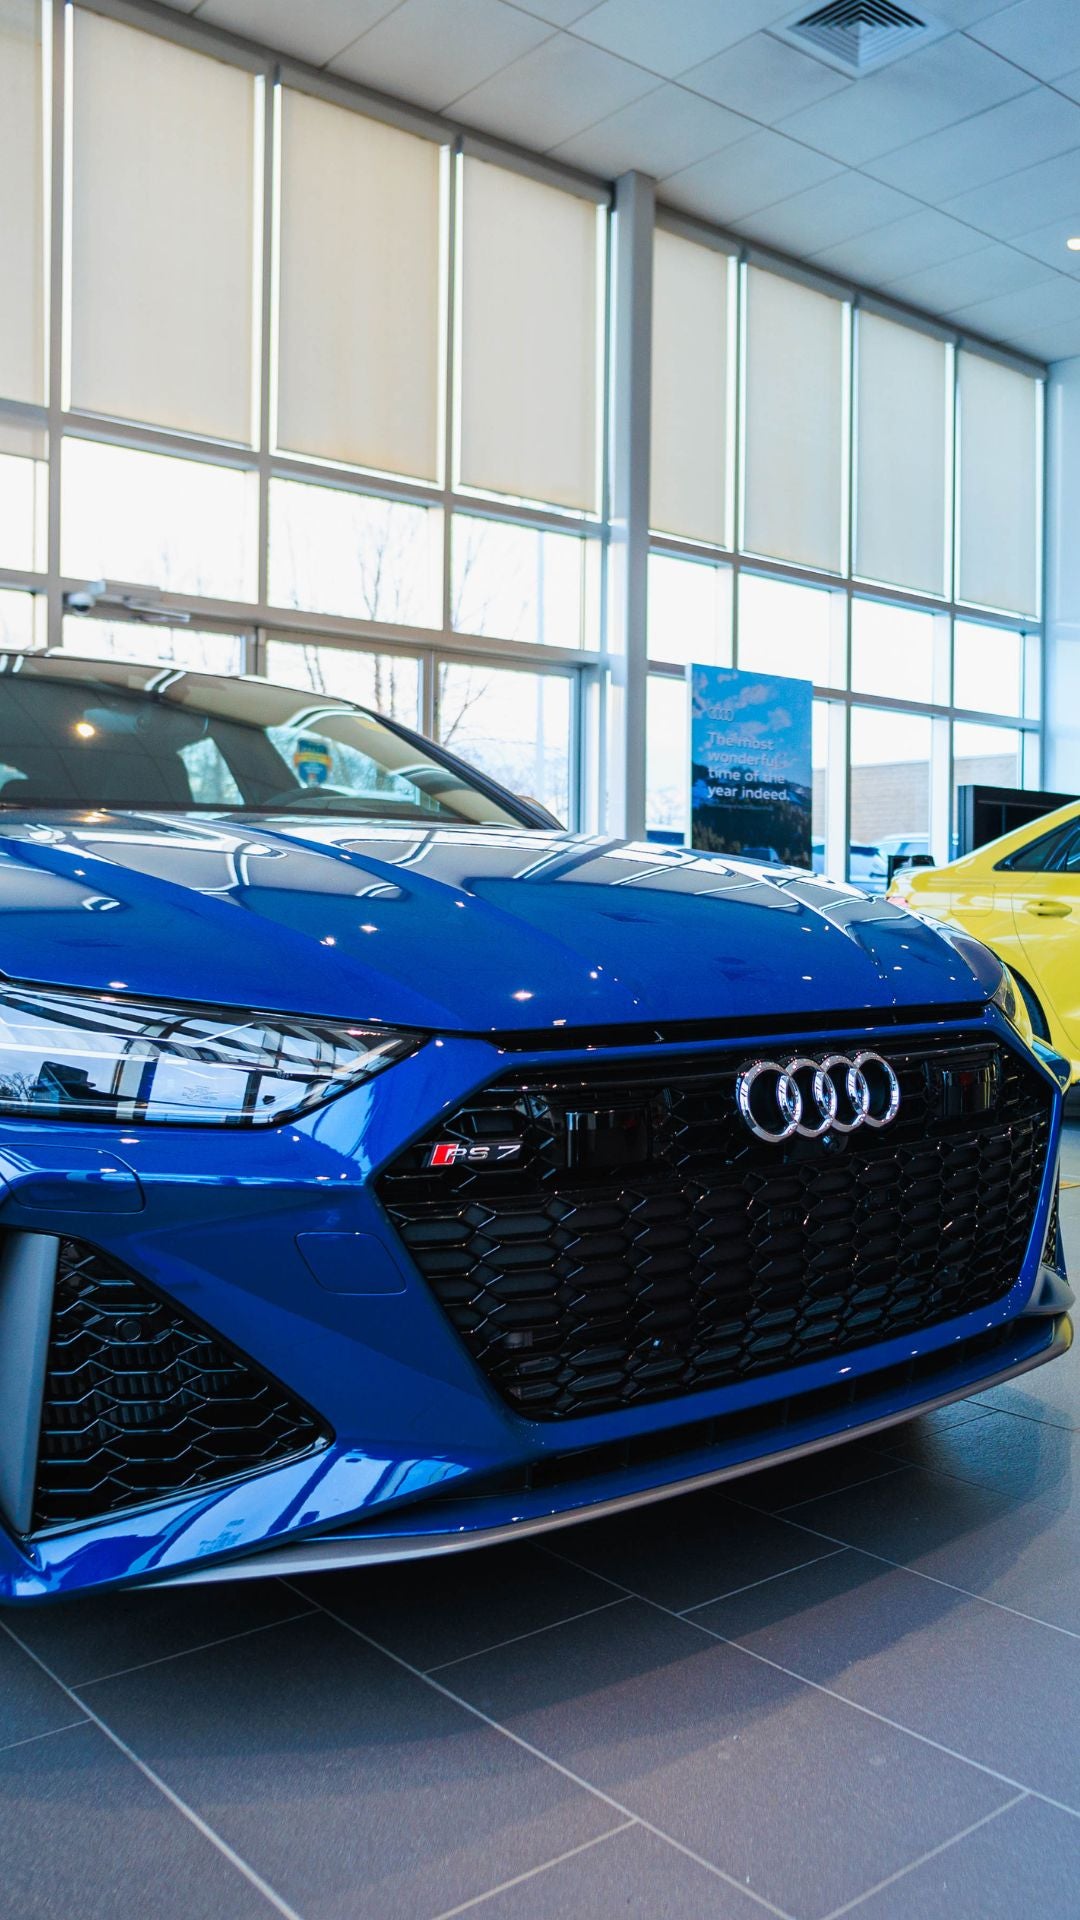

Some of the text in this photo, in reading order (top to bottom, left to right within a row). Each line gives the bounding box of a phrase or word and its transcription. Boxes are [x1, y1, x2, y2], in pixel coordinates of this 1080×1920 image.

[706, 731, 774, 750] The most
[707, 751, 779, 766] wonderful
[707, 768, 785, 784] time of the
[707, 786, 791, 801] year indeed.
